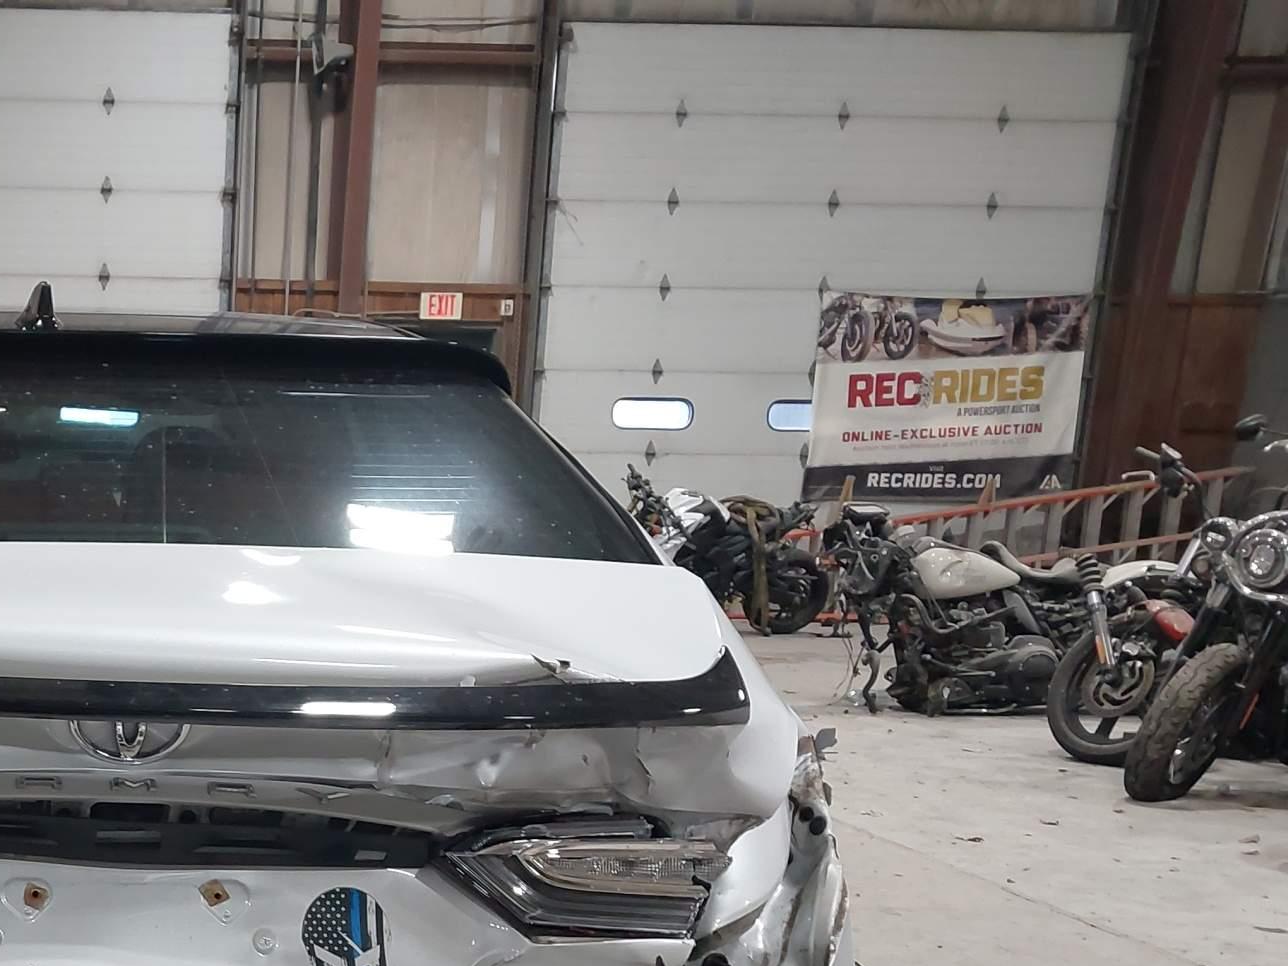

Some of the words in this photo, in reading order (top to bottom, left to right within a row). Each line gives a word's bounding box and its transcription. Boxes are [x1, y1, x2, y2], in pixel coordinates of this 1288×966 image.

[427, 294, 457, 317] EXIT
[847, 371, 923, 409] REC
[932, 365, 1046, 405] RIDES
[841, 425, 980, 443] ONLINE-EXCLUSIVE
[983, 422, 1044, 436] AUCTION
